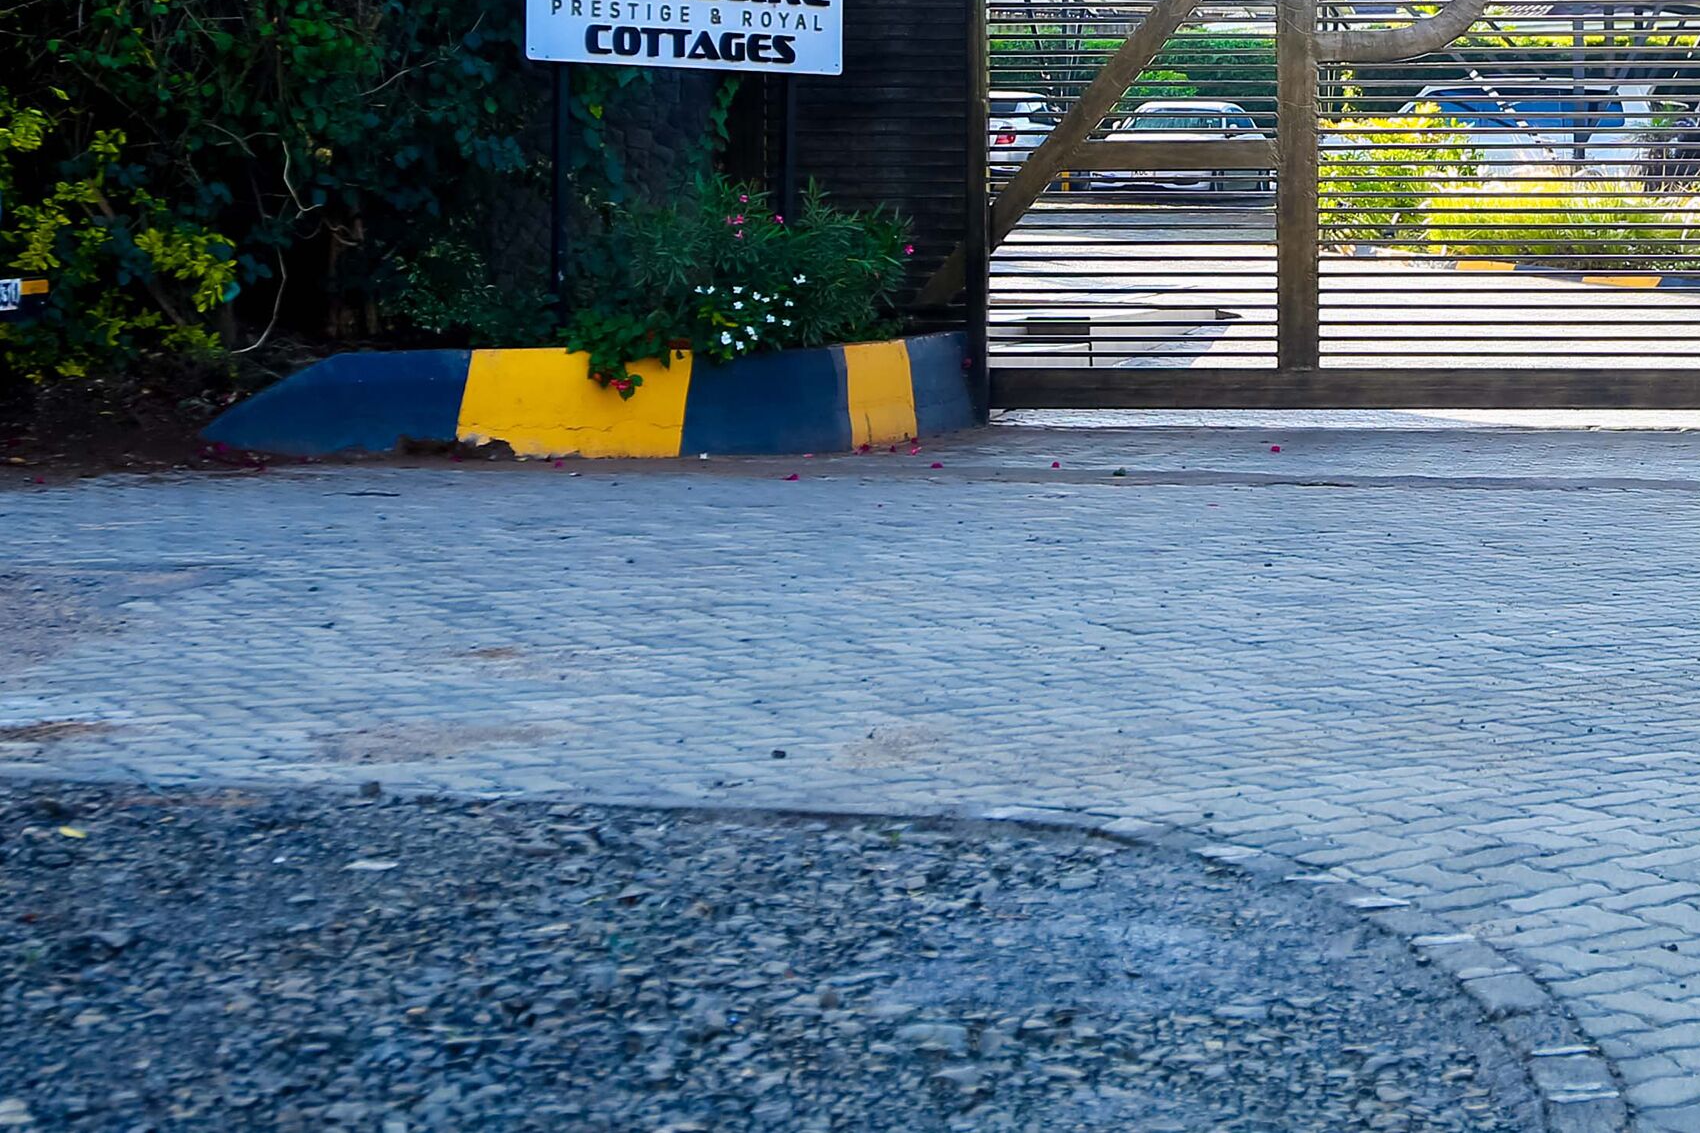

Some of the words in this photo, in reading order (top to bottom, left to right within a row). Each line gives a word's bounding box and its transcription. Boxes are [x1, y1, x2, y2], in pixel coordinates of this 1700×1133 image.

[710, 7, 722, 24] &
[742, 11, 823, 32] ROYAL
[585, 24, 796, 64] COTTAGES
